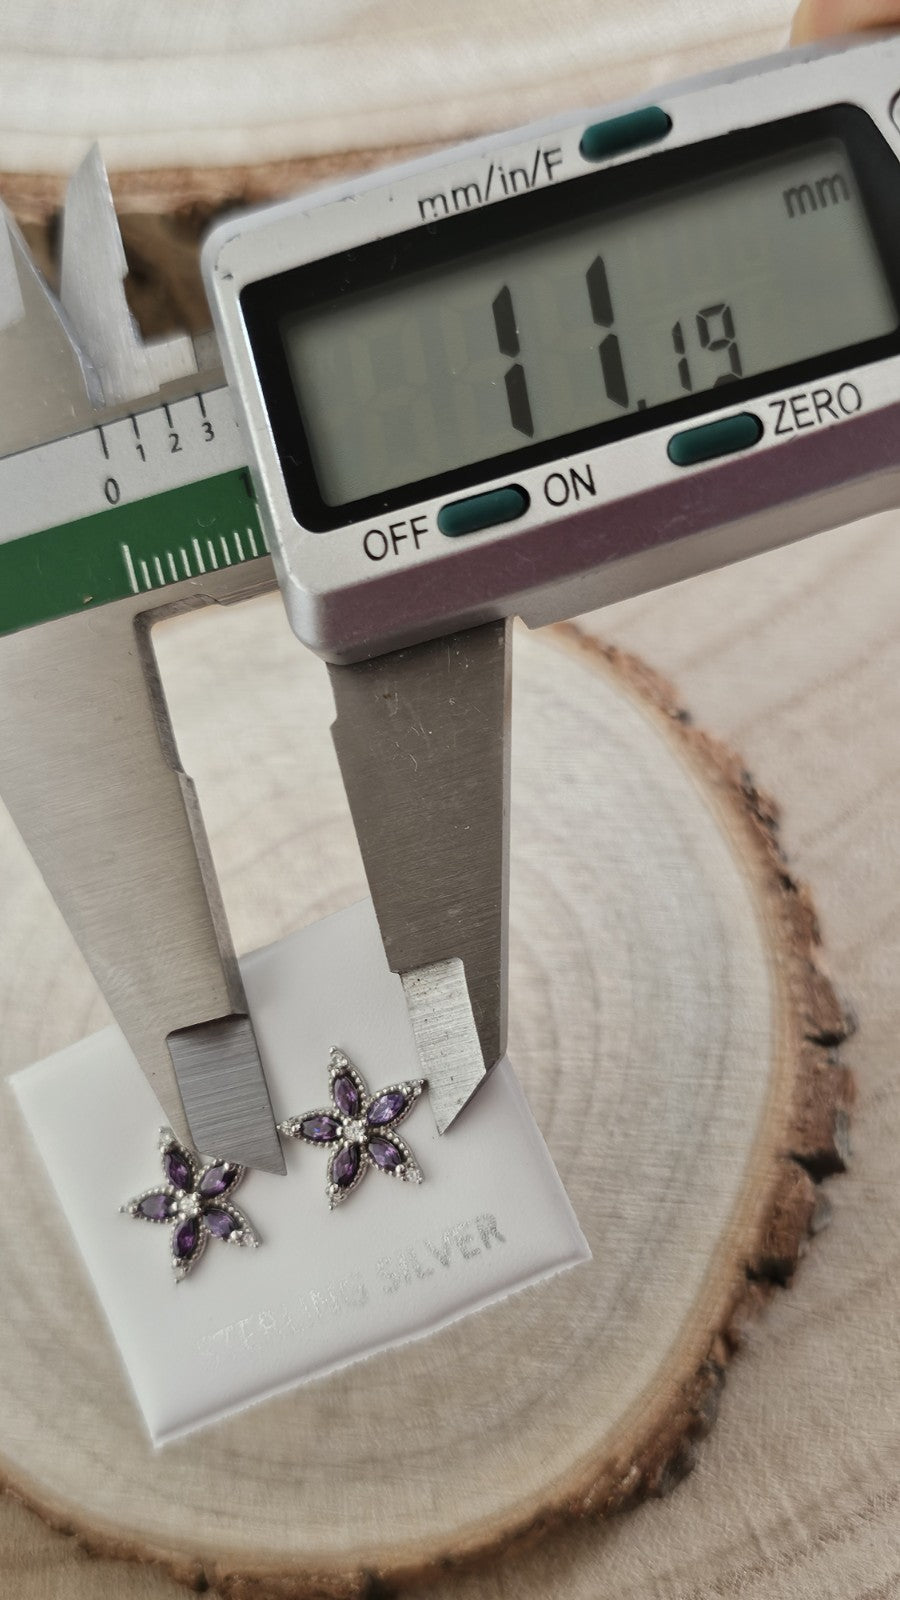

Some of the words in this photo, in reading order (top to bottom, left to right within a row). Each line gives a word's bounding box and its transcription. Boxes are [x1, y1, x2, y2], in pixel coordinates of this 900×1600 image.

[418, 148, 564, 220] mm/in/F
[782, 169, 850, 218] mm
[491, 255, 743, 438] 11.19
[768, 381, 863, 436] ZERO
[104, 478, 120, 505] 0
[136, 444, 146, 462] 1
[169, 433, 182, 453] 2
[201, 422, 215, 441] 3
[362, 515, 429, 562] OFF
[543, 463, 597, 507] ON
[375, 1212, 506, 1295] SILVER
